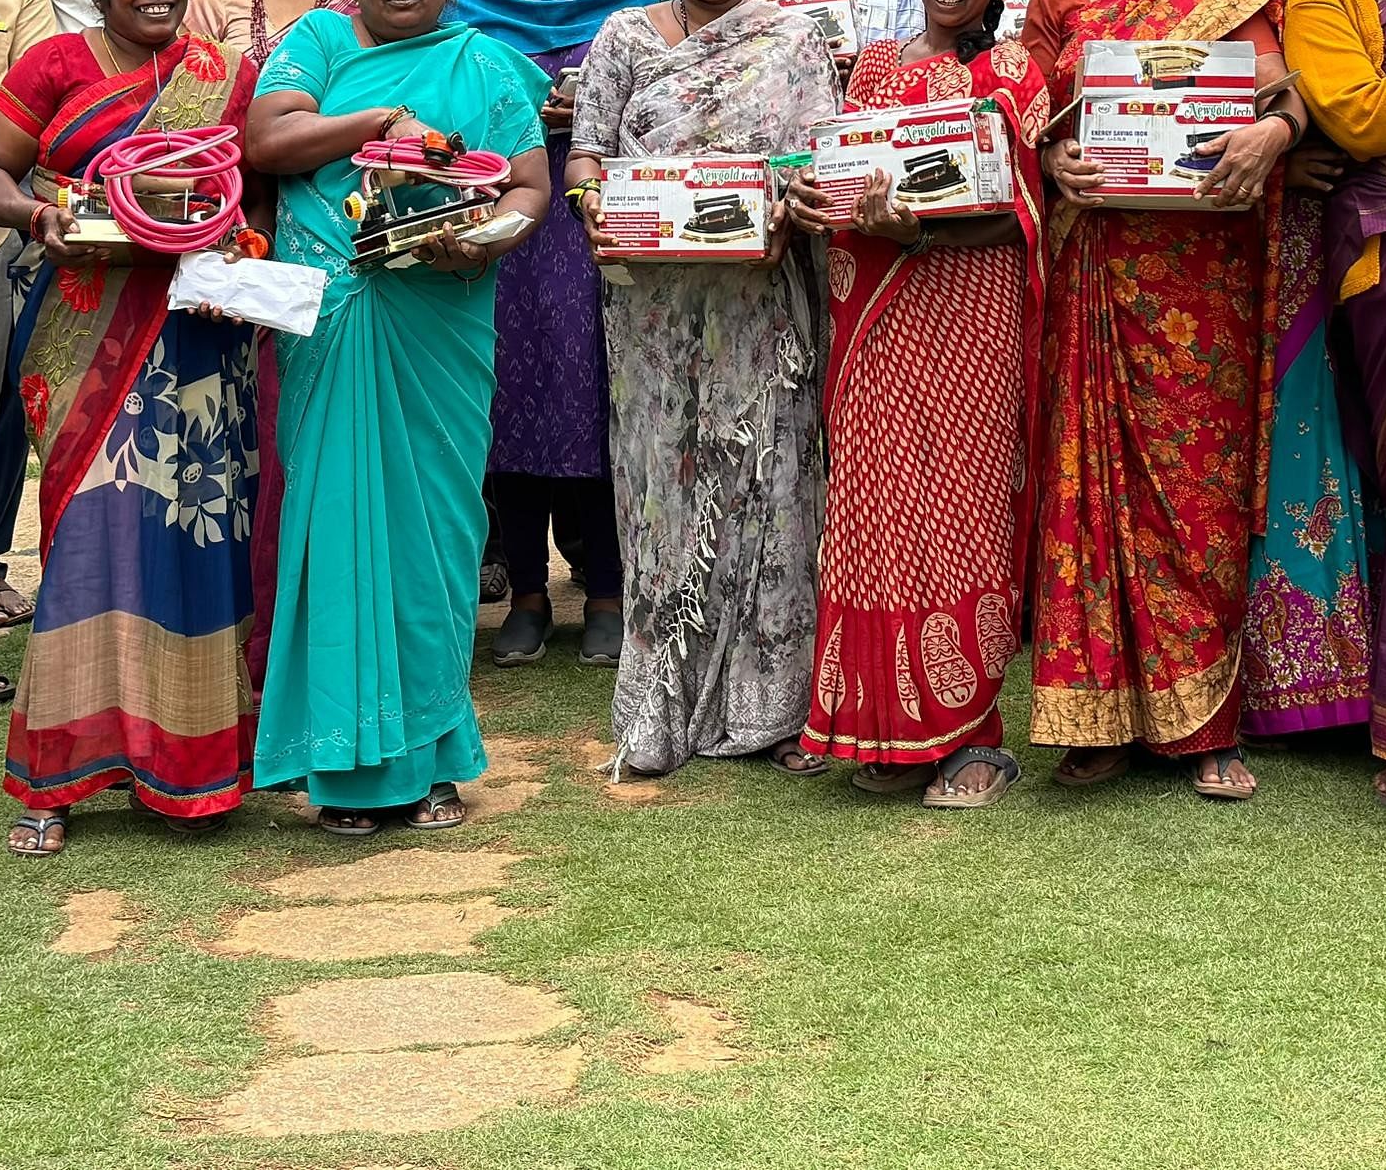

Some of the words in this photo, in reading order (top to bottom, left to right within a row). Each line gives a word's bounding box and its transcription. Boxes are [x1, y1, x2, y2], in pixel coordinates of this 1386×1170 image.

[1184, 102, 1232, 122] Newgold
[1233, 106, 1252, 116] tech
[900, 120, 946, 142] Newgold
[948, 124, 966, 134] tech
[693, 165, 739, 186] Newgold
[742, 170, 759, 180] tech
